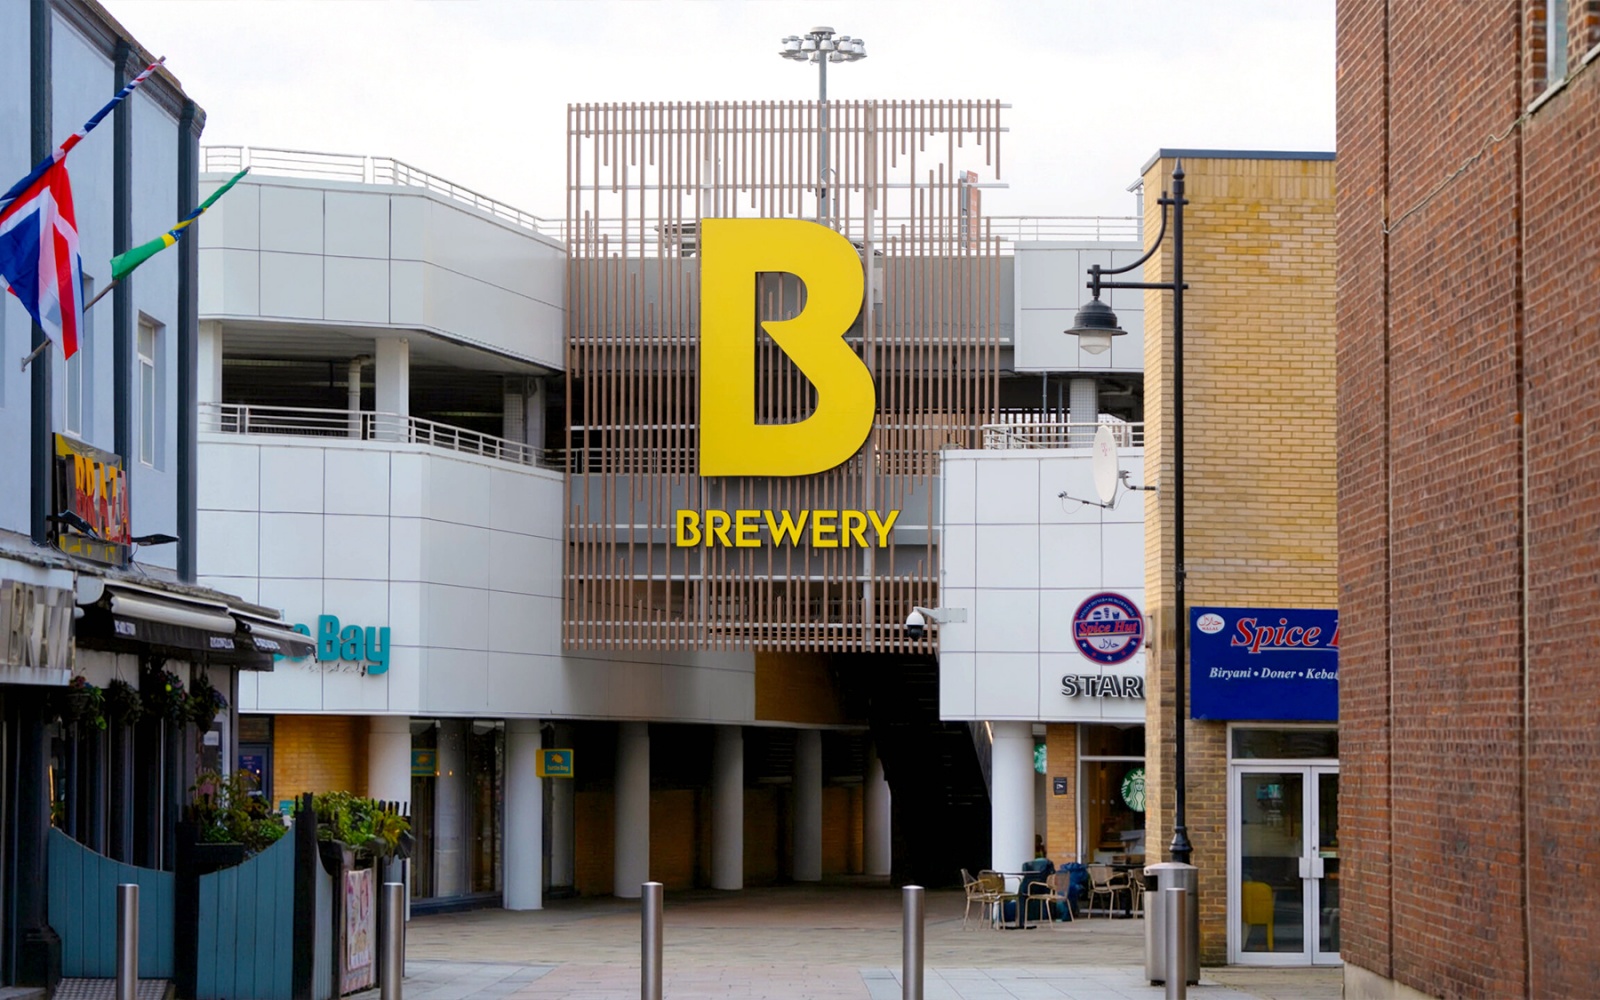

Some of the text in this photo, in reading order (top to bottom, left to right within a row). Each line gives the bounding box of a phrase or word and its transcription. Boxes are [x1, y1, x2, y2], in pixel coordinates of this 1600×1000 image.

[701, 218, 876, 477] B
[66, 453, 132, 546] BRAZA
[676, 510, 900, 548] BREWERY
[318, 614, 391, 674] Bay
[1079, 620, 1138, 636] Spice Hut
[1230, 617, 1322, 654] Spice
[1061, 674, 1145, 699] STAR
[1209, 667, 1252, 680] Biryani
[1261, 667, 1297, 679] Doner
